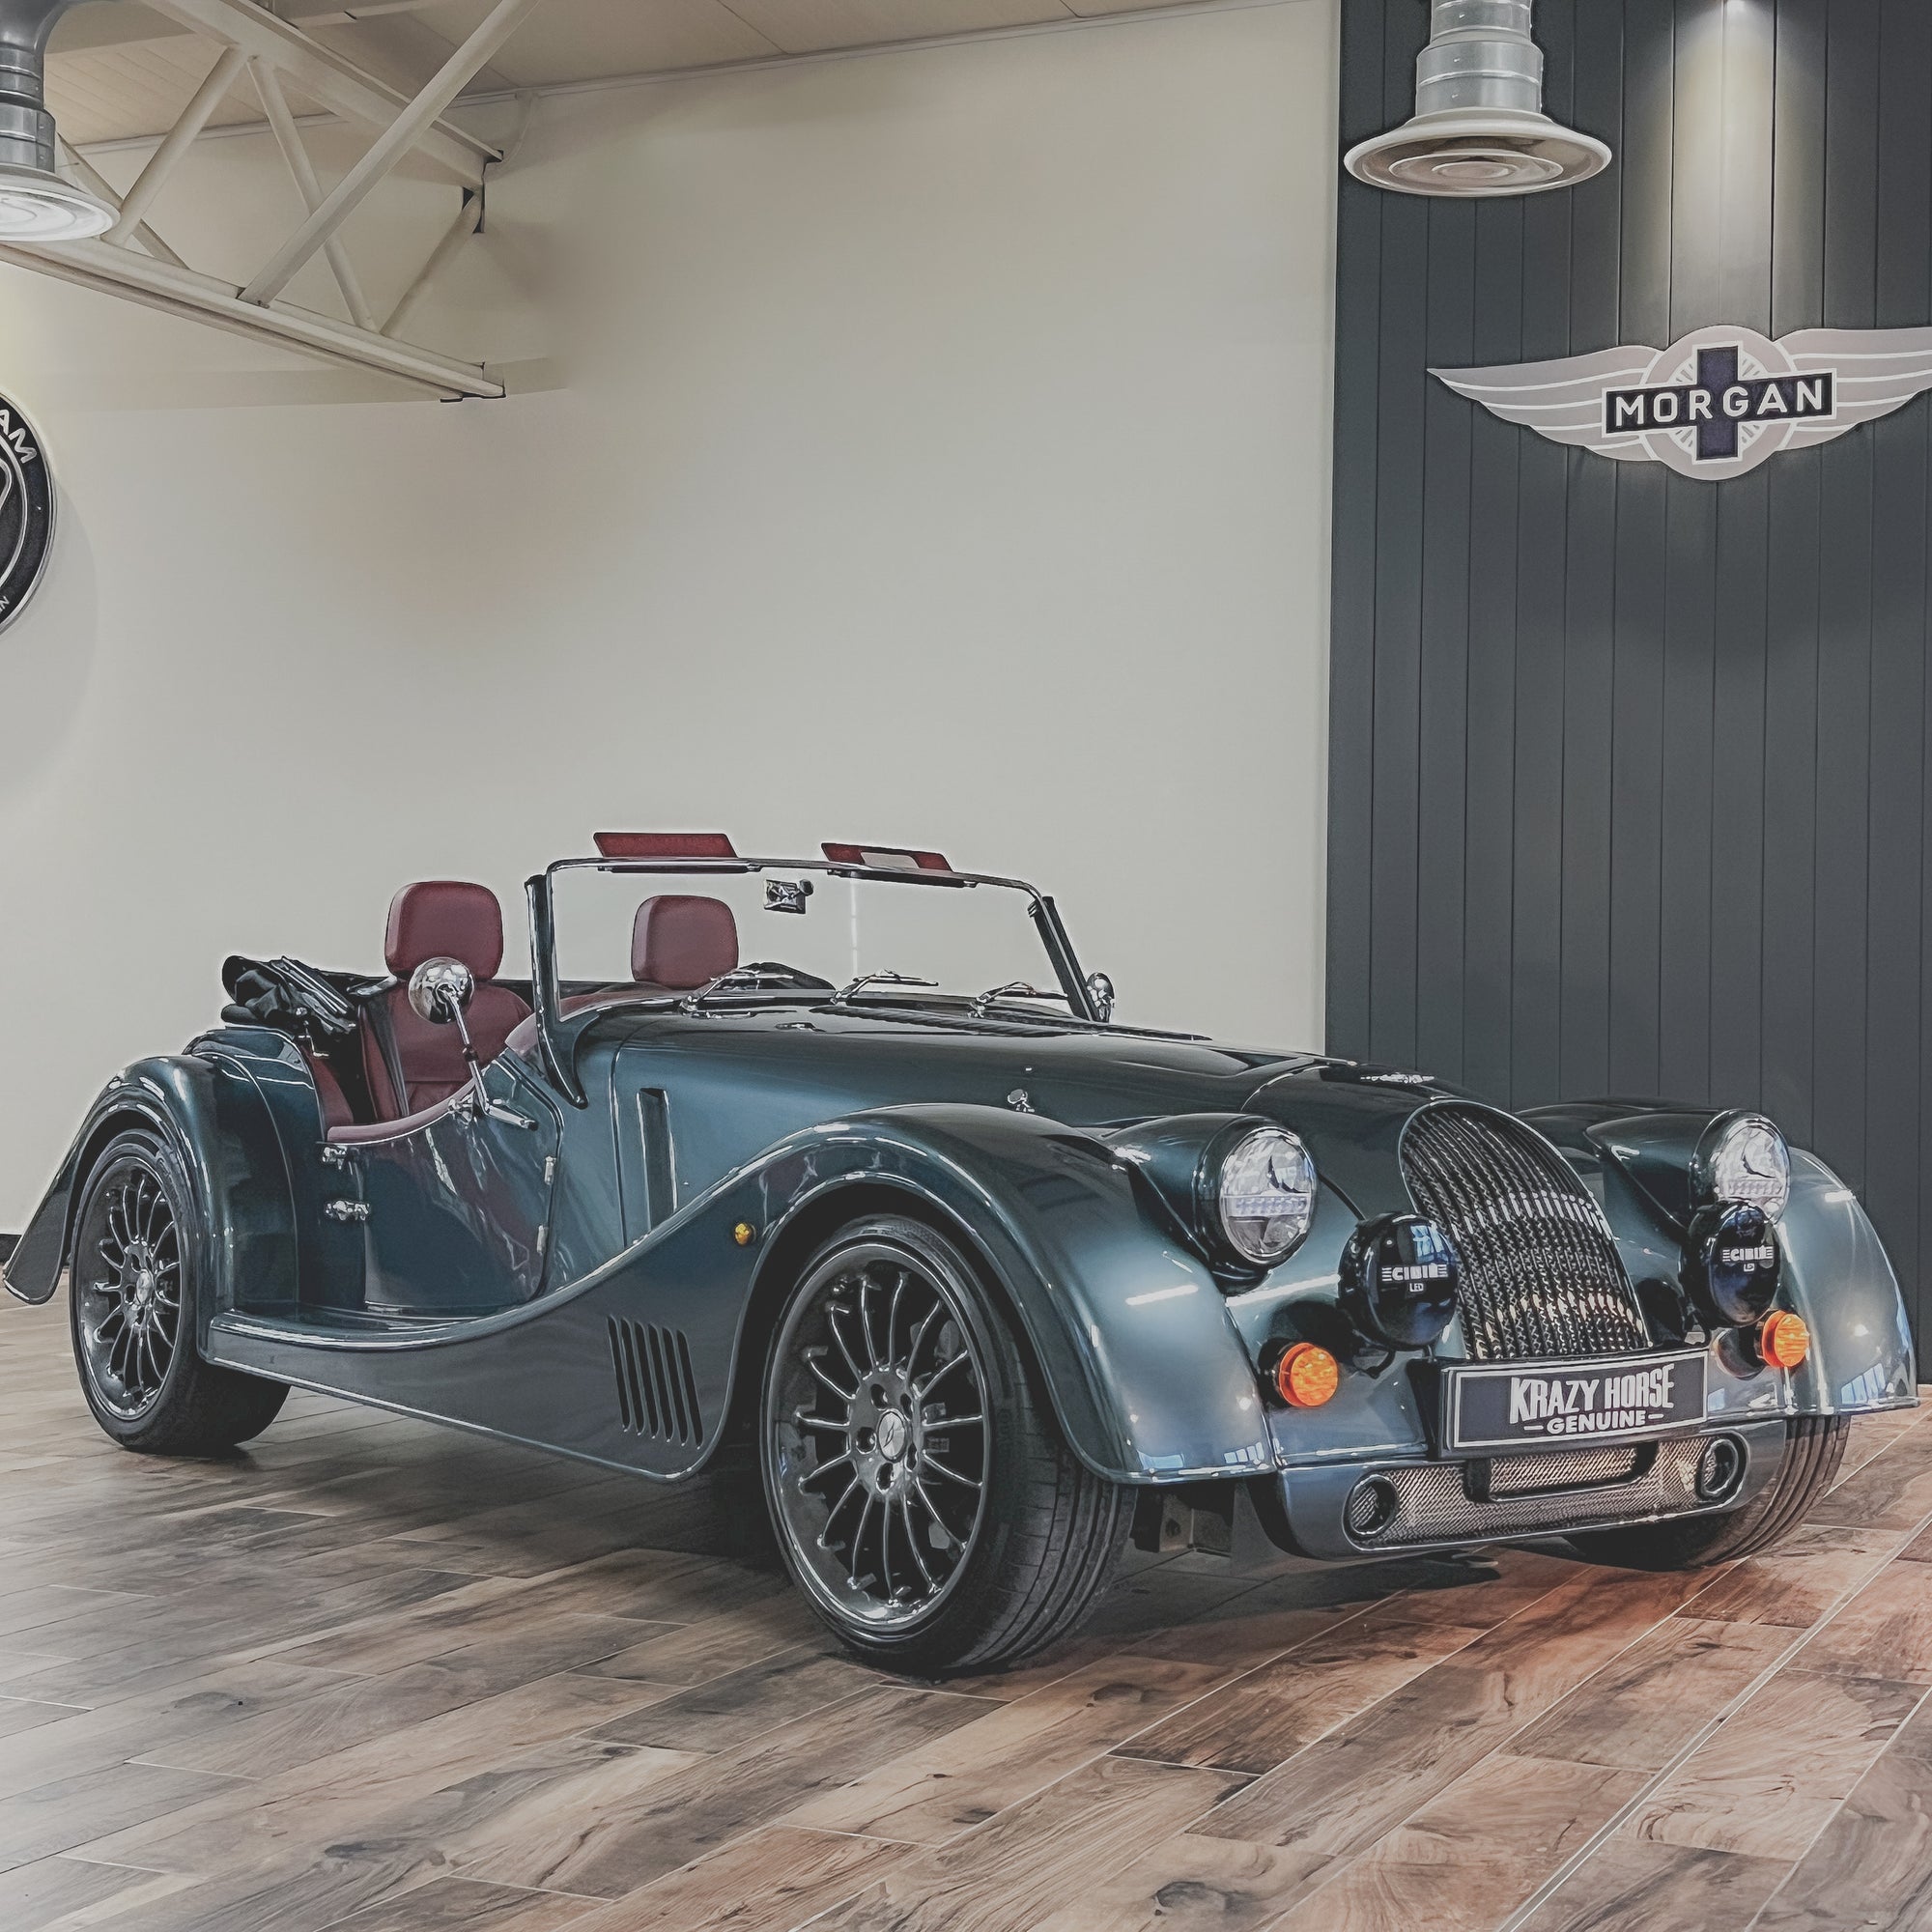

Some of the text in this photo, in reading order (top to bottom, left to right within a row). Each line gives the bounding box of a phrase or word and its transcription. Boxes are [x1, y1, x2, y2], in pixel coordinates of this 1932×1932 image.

[1615, 379, 1823, 427] MORGAN
[1509, 1363, 1675, 1424] KRAZY HORSE
[1547, 1409, 1647, 1435] GENUINE
